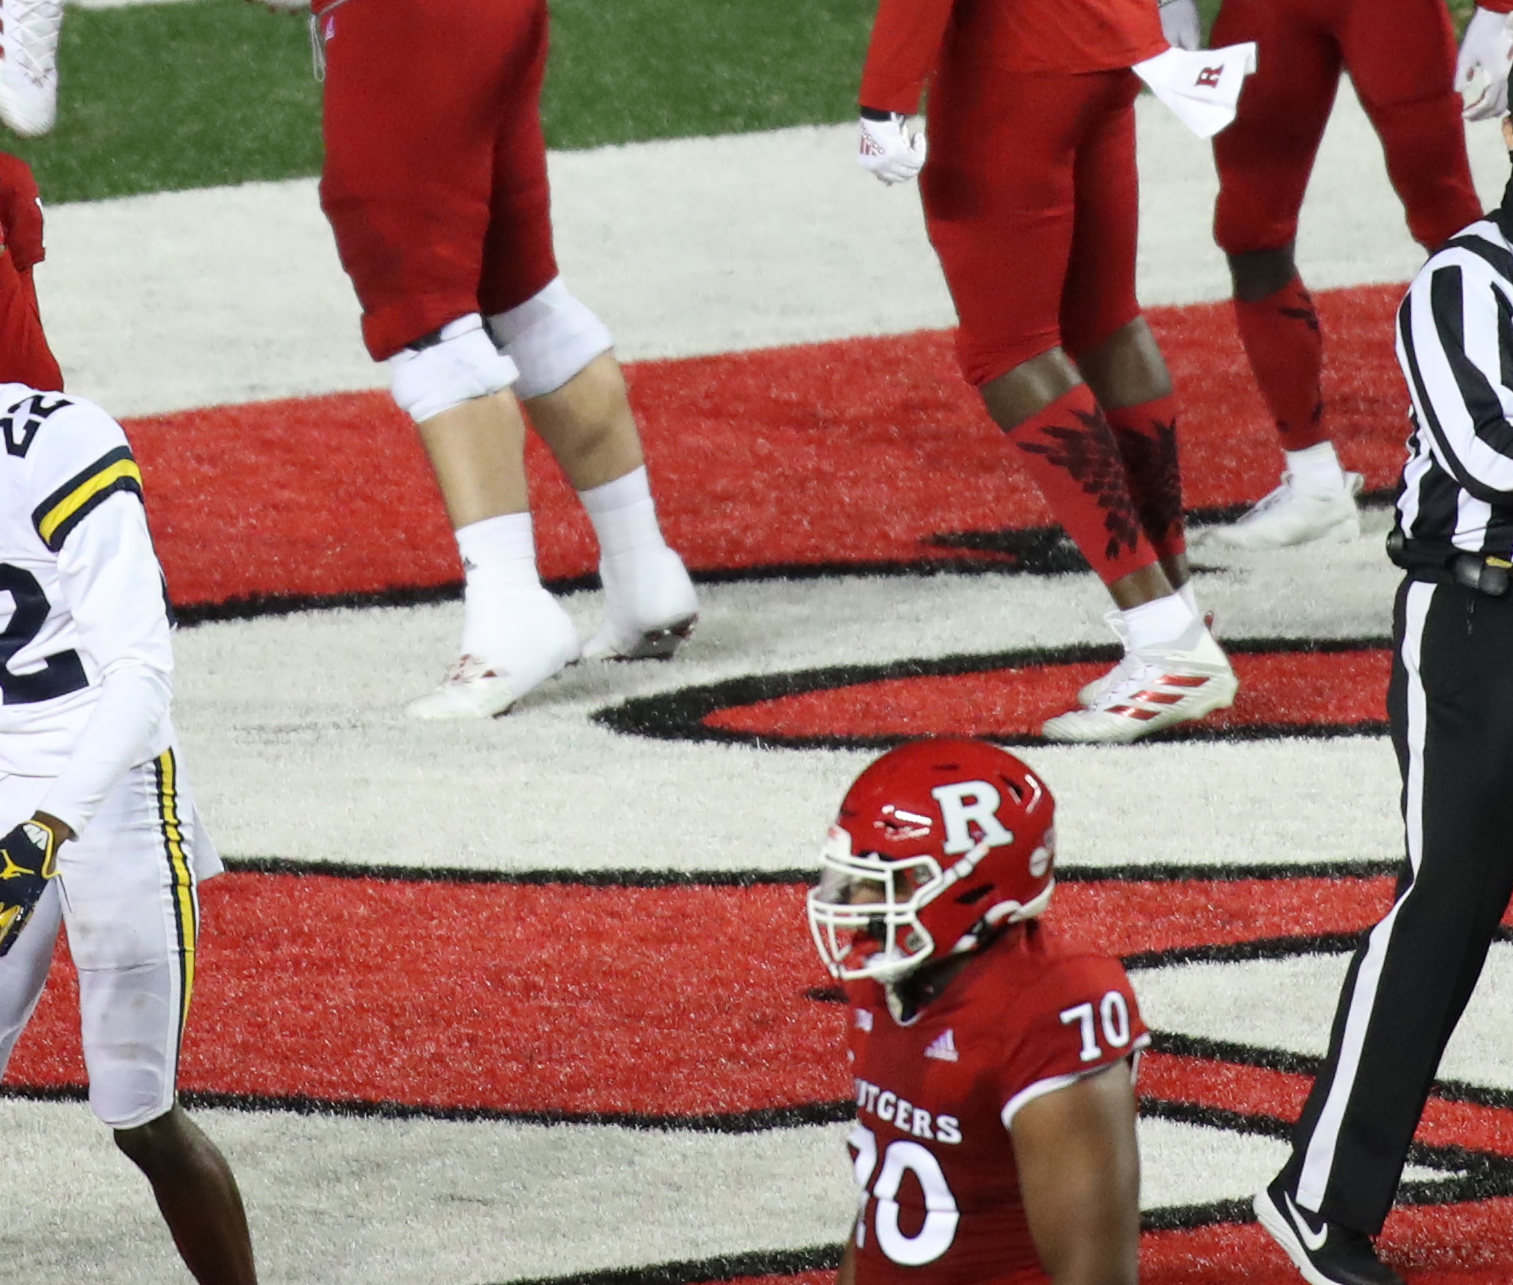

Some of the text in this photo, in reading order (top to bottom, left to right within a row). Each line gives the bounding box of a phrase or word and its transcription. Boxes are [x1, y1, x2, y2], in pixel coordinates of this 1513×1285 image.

[1195, 64, 1224, 89] R
[931, 779, 1014, 855] R
[1059, 990, 1131, 1062] 70
